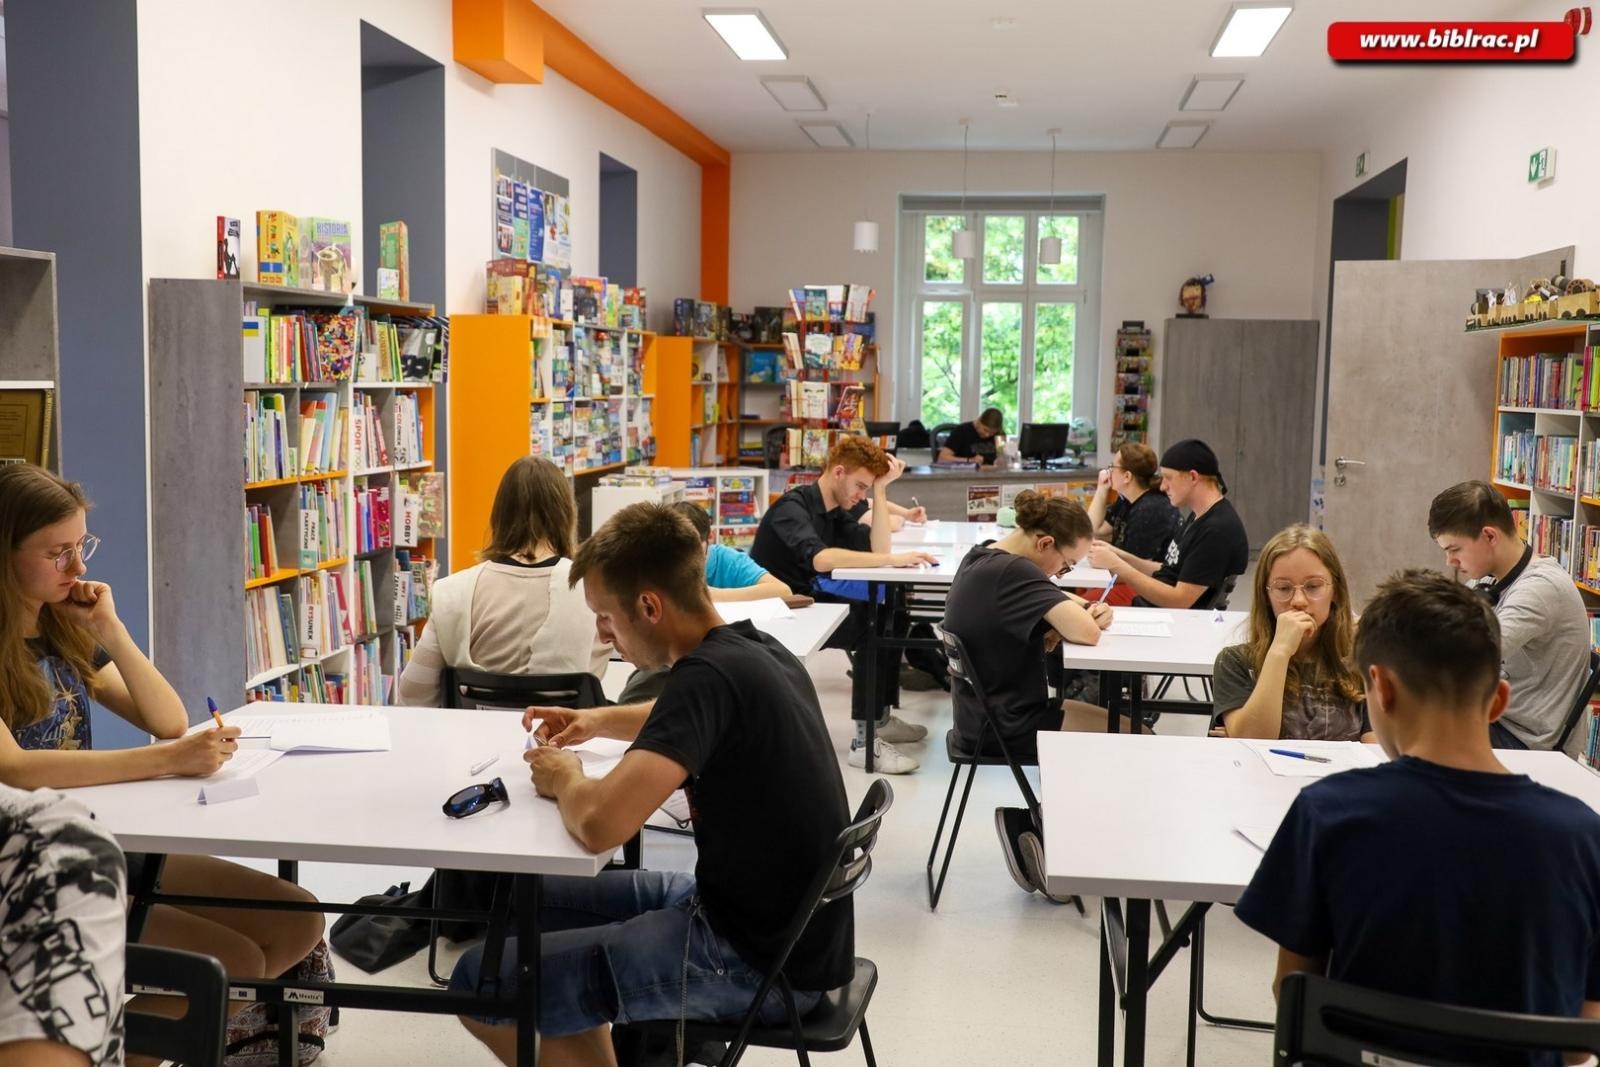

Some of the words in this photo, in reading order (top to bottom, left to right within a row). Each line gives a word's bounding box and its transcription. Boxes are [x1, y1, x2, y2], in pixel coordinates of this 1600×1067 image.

[316, 221, 349, 235] HISTORIA
[354, 419, 362, 452] SPORT
[403, 511, 412, 544] HOBBY
